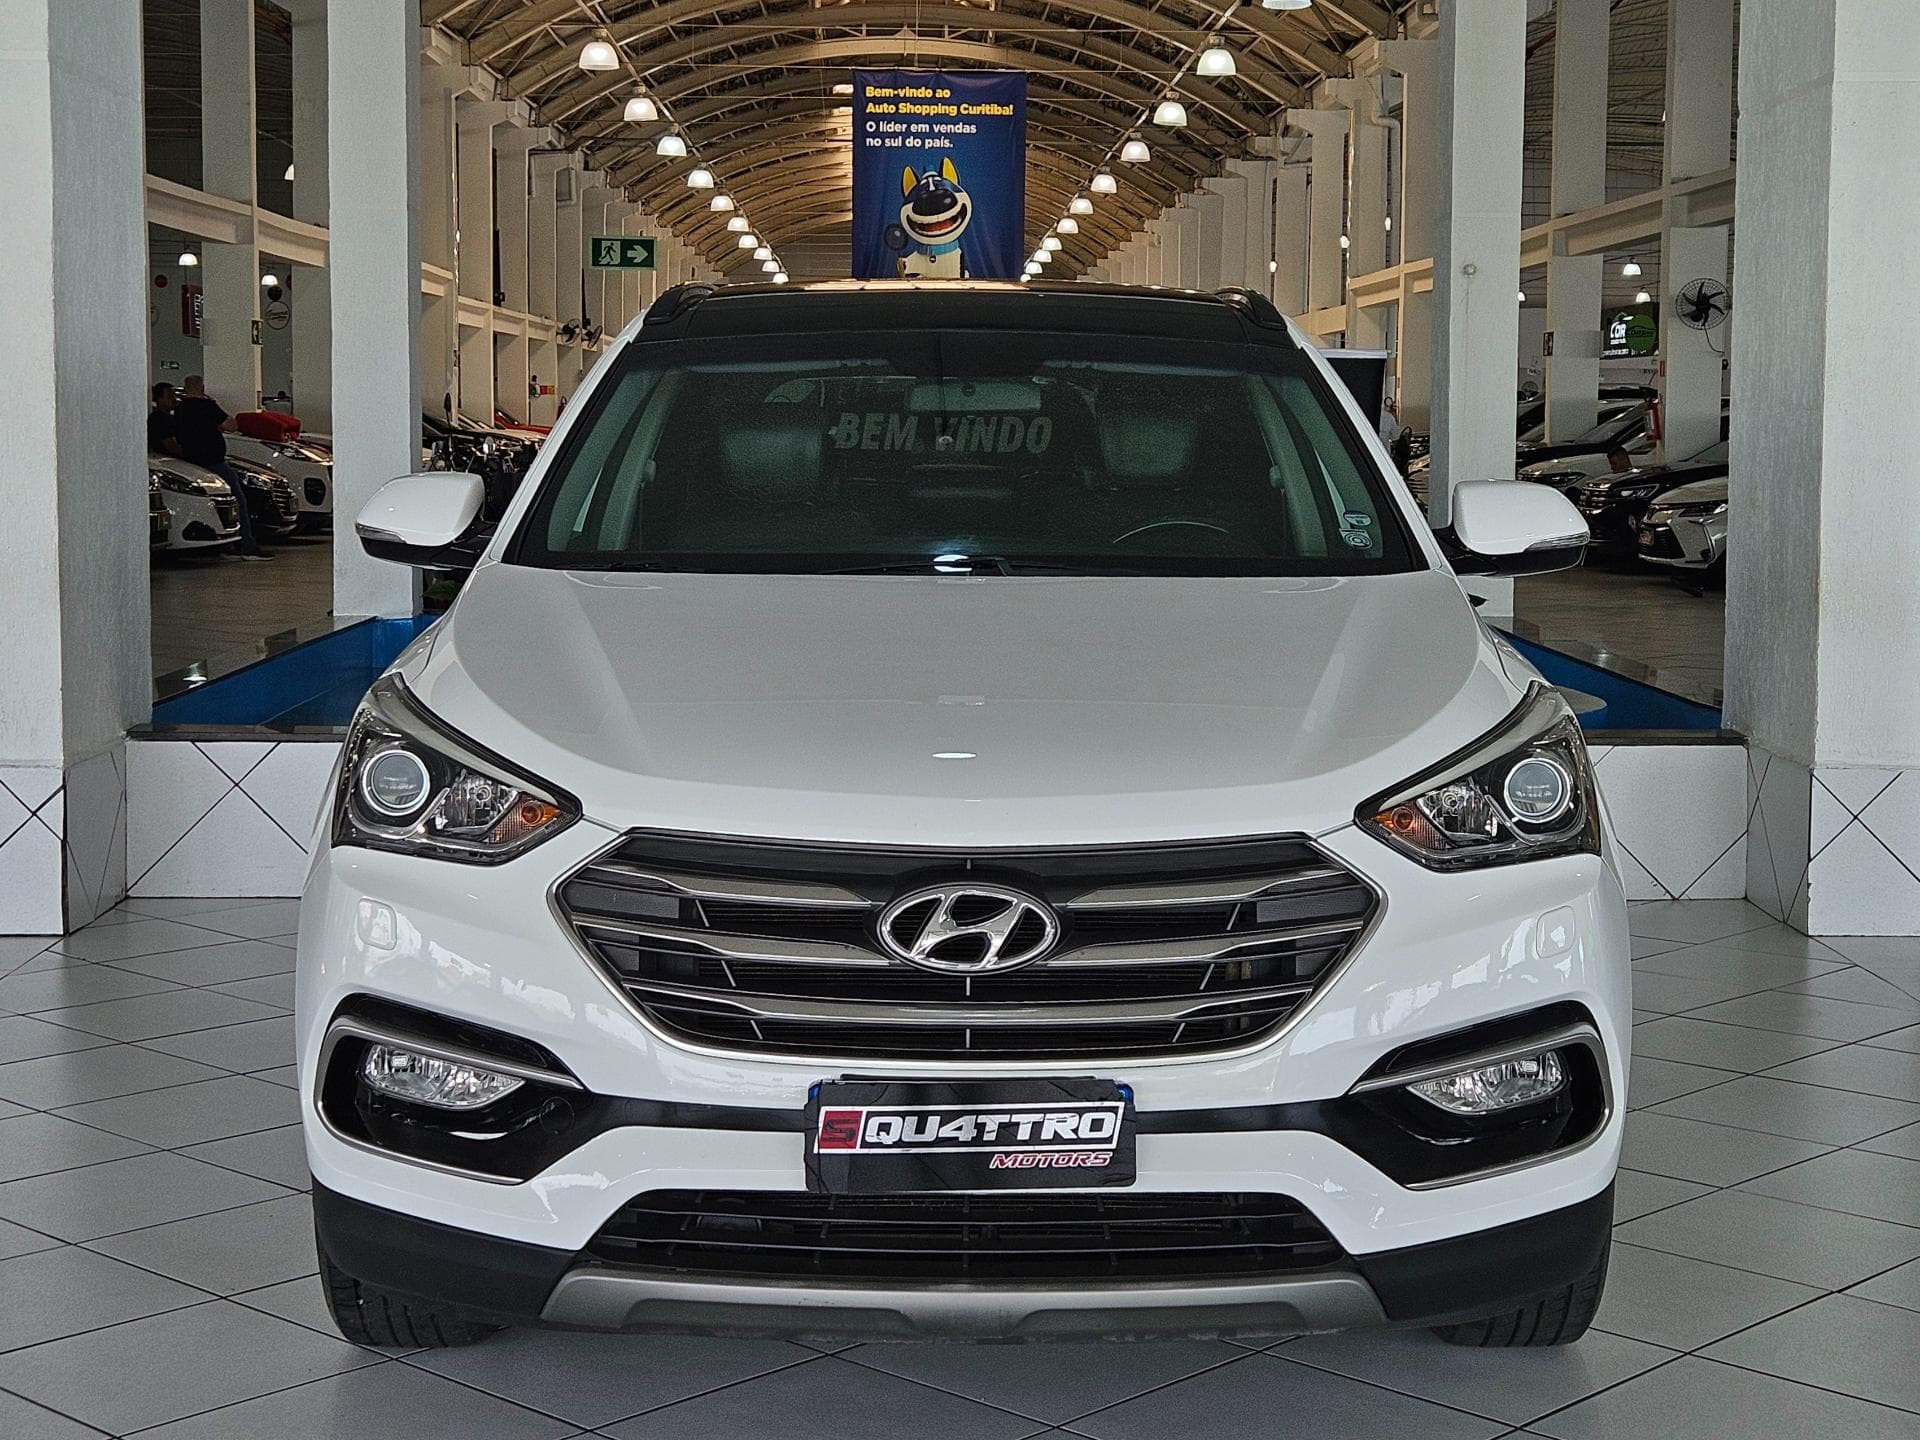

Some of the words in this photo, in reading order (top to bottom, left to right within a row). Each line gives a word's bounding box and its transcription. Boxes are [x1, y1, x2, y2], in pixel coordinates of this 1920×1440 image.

[865, 86, 934, 98] Bem-vindo
[935, 88, 951, 98] ao
[865, 102, 897, 113] Auto
[898, 102, 958, 117] Shopping
[959, 103, 1014, 115] Curitiba!
[865, 121, 877, 132] O
[879, 120, 908, 132] líder
[910, 123, 930, 133] em
[932, 121, 977, 133] vendas
[865, 137, 882, 147] no
[884, 135, 903, 147] sul
[905, 135, 922, 147] do
[924, 135, 954, 149] país.
[833, 412, 919, 451] BEM
[934, 415, 1053, 453] VINDO
[988, 1151, 1113, 1169] MOTORS
